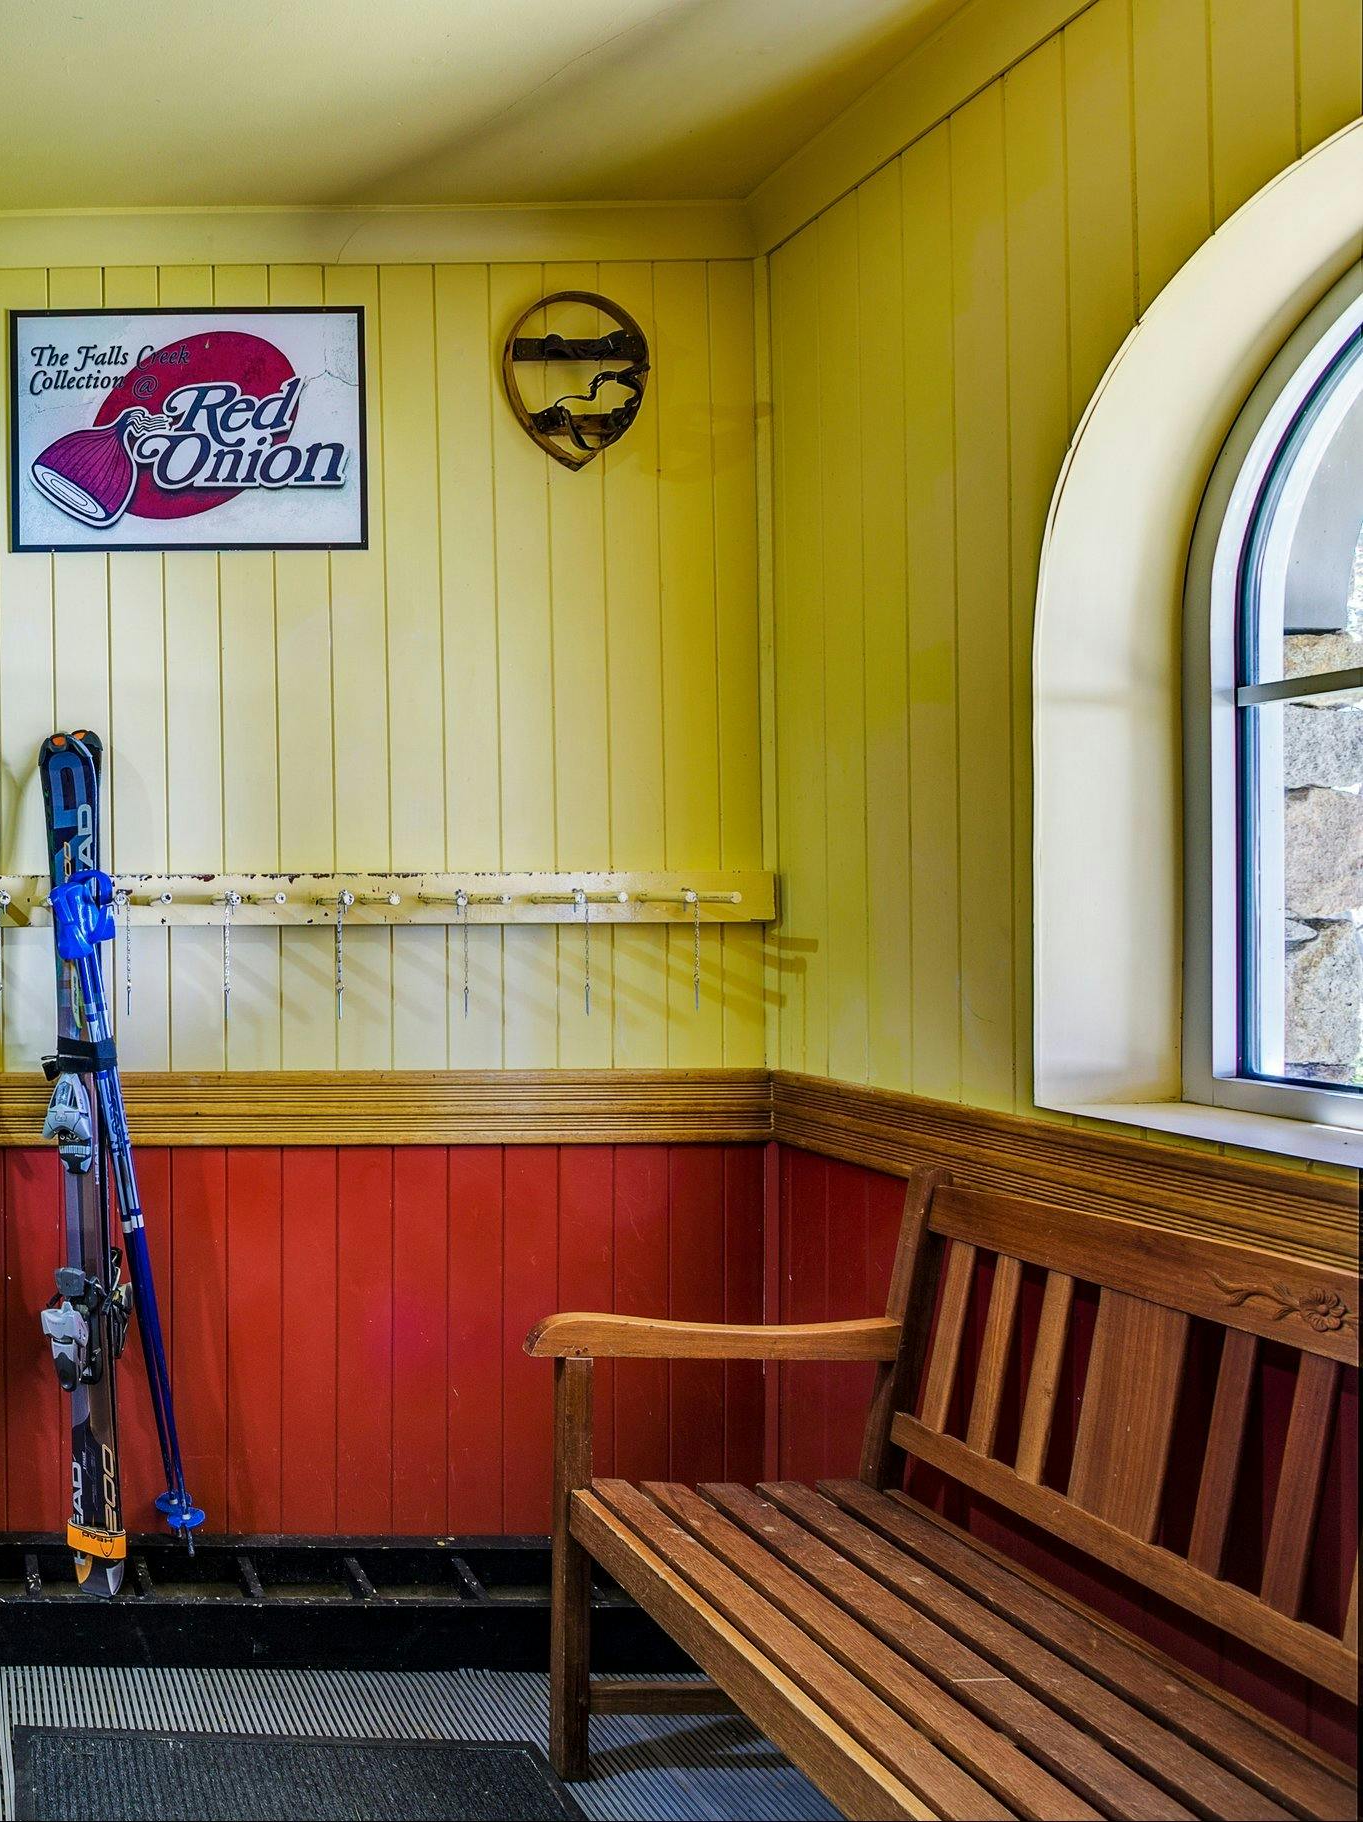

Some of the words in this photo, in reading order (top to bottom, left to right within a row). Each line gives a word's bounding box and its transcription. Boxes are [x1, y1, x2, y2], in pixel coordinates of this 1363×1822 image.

[30, 344, 68, 367] The
[77, 345, 129, 372] Falls
[135, 344, 191, 370] Creek
[29, 369, 125, 396] Collection
[132, 375, 160, 400] @
[166, 377, 301, 448] Red
[136, 432, 345, 484] Onion
[82, 1531, 114, 1544] HEAD
